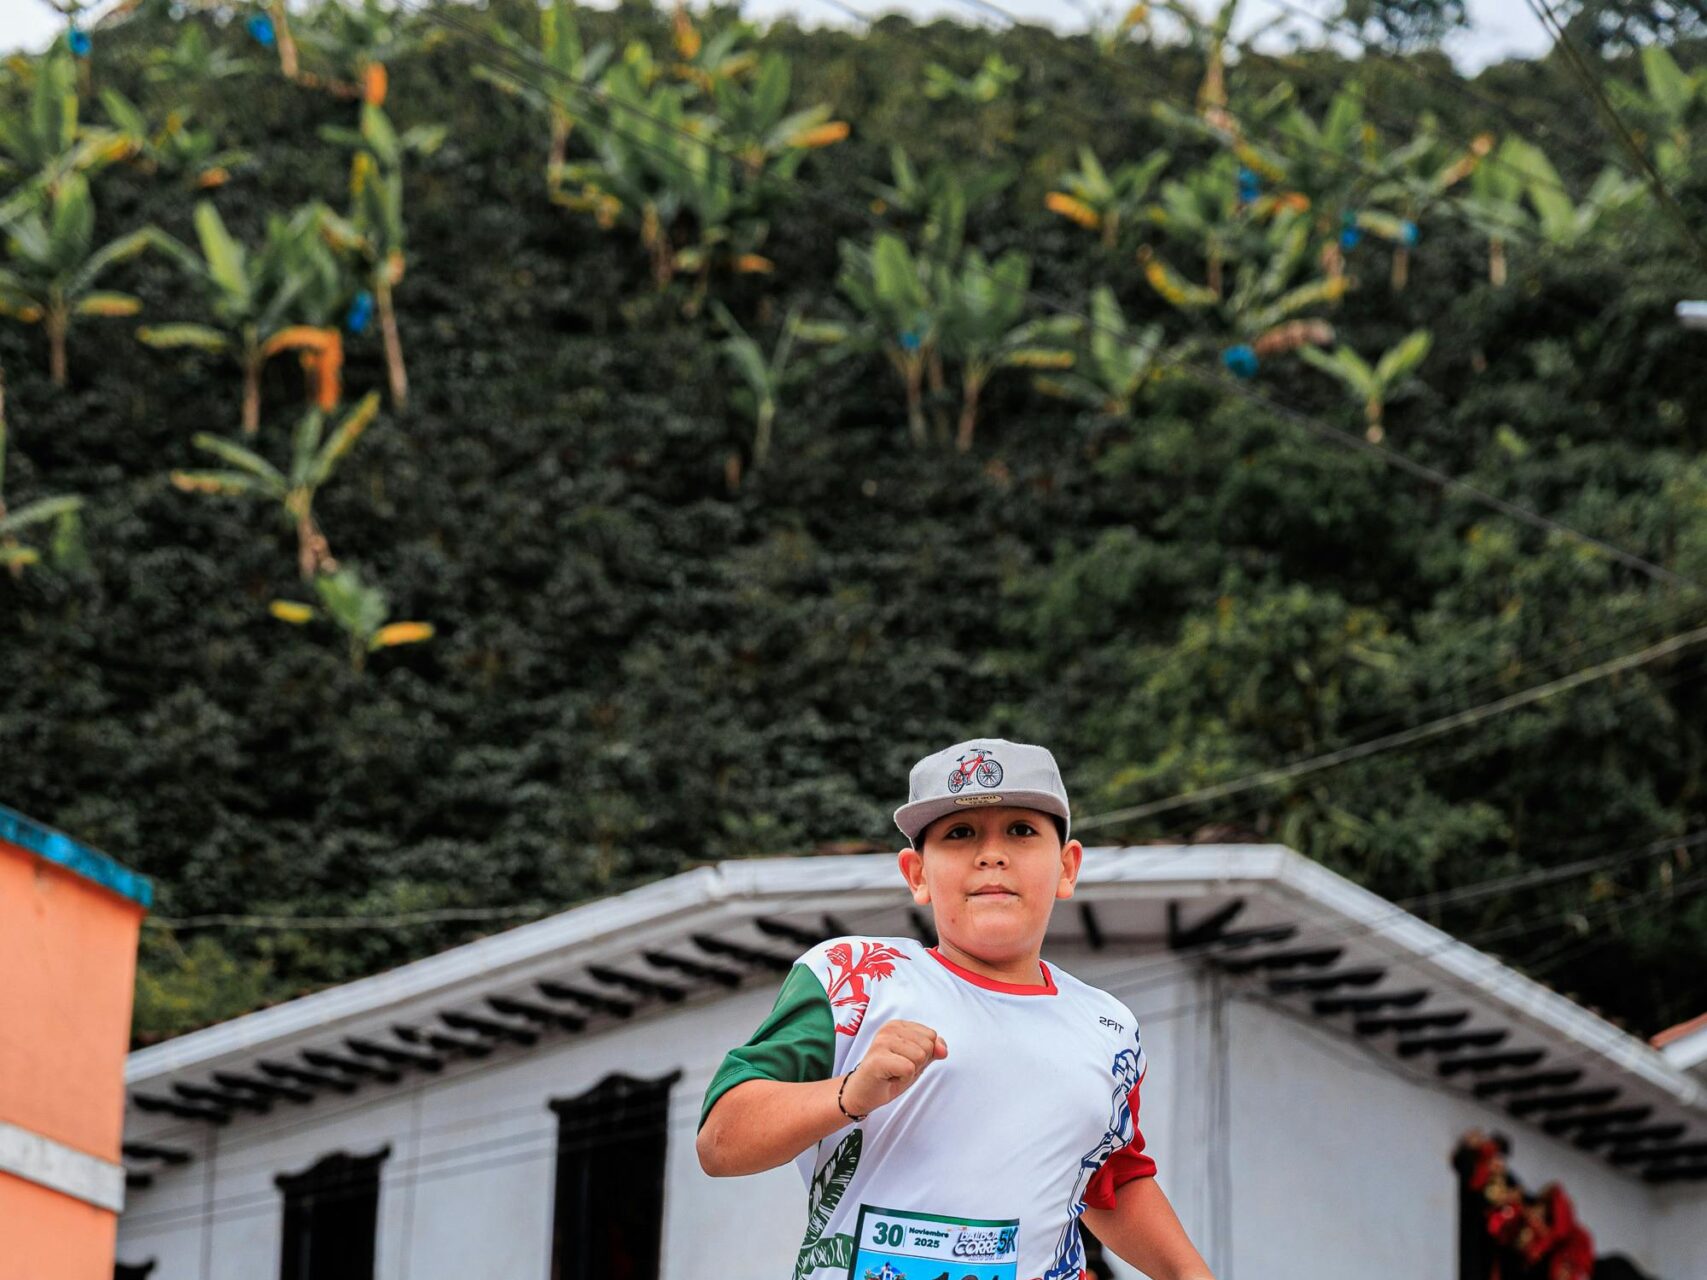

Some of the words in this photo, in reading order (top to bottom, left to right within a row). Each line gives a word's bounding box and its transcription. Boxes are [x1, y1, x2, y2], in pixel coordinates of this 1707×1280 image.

[1099, 1016, 1124, 1034] 2FIT
[872, 1222, 904, 1247] 30
[909, 1227, 949, 1239] Noviembre
[996, 1226, 1018, 1254] 5K
[914, 1238, 940, 1248] 2025
[952, 1240, 998, 1256] CORRE
